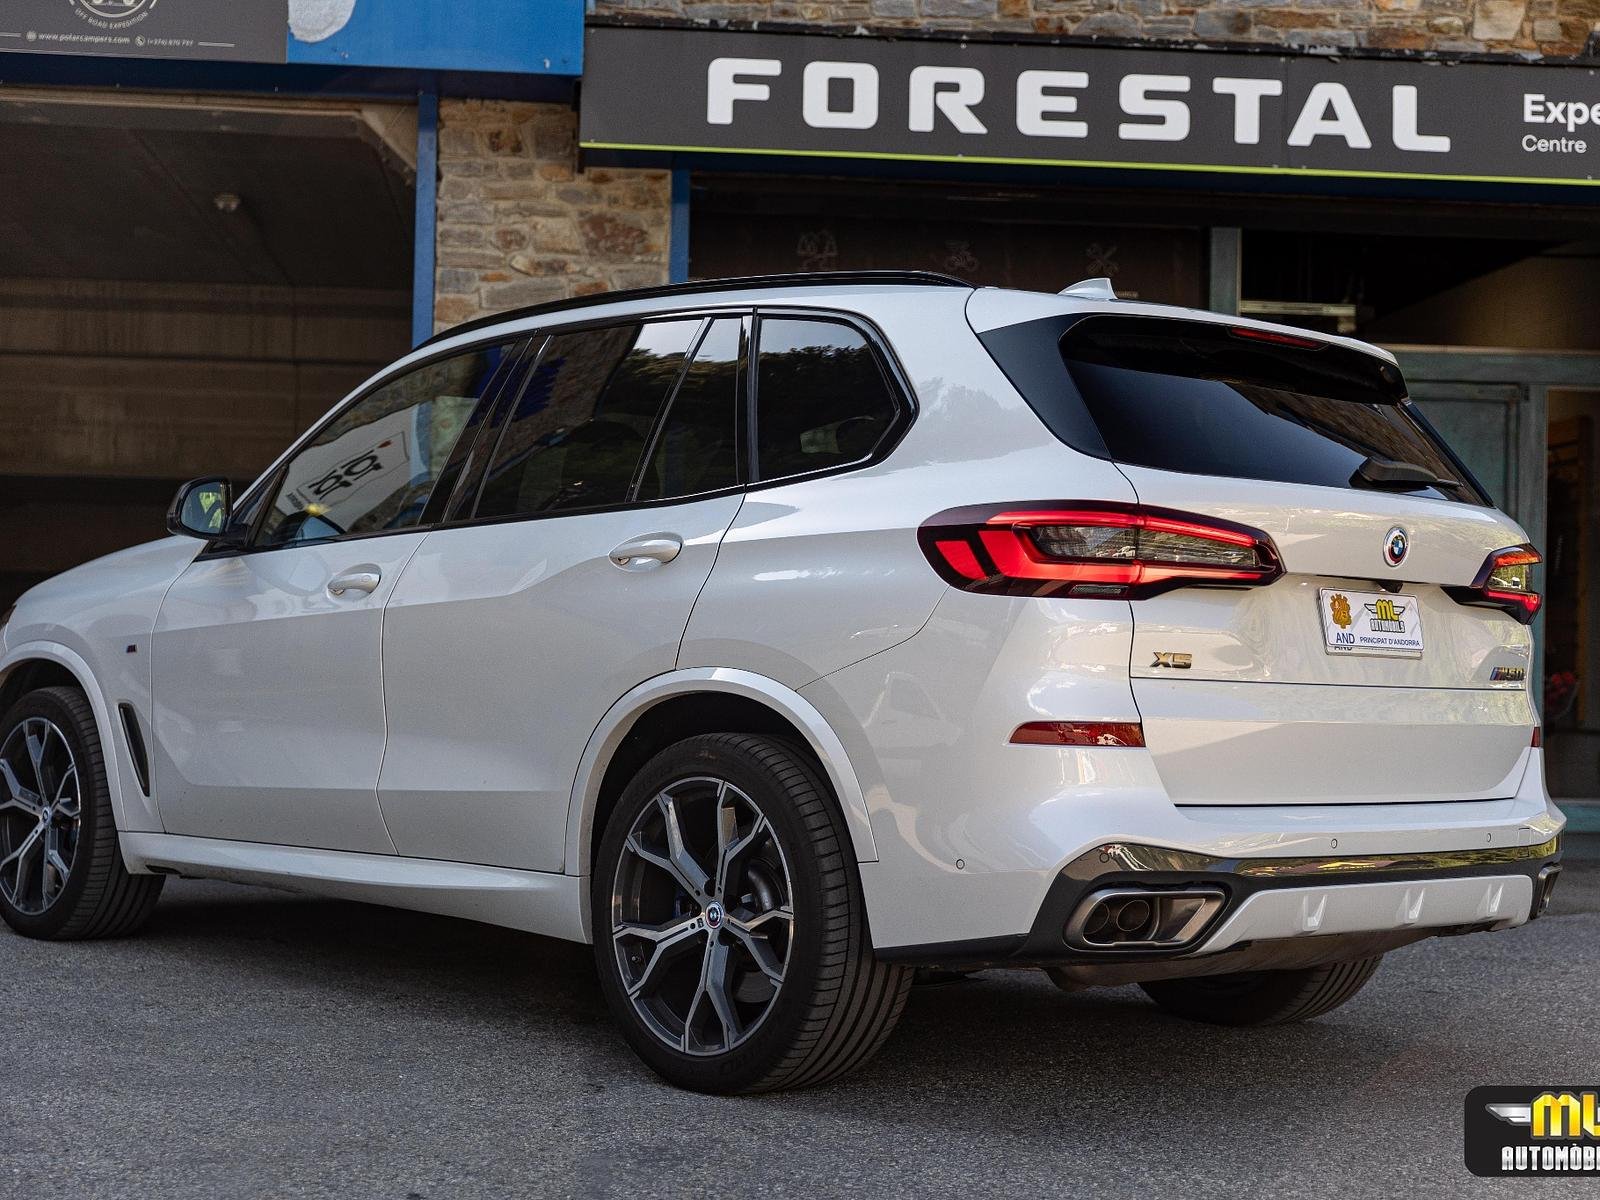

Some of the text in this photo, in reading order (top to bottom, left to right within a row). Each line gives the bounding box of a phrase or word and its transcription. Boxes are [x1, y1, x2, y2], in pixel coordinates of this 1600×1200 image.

[706, 57, 1451, 153] FORESTAL
[1522, 134, 1587, 154] Centre
[1336, 632, 1355, 644] AND
[1150, 651, 1192, 669] X5
